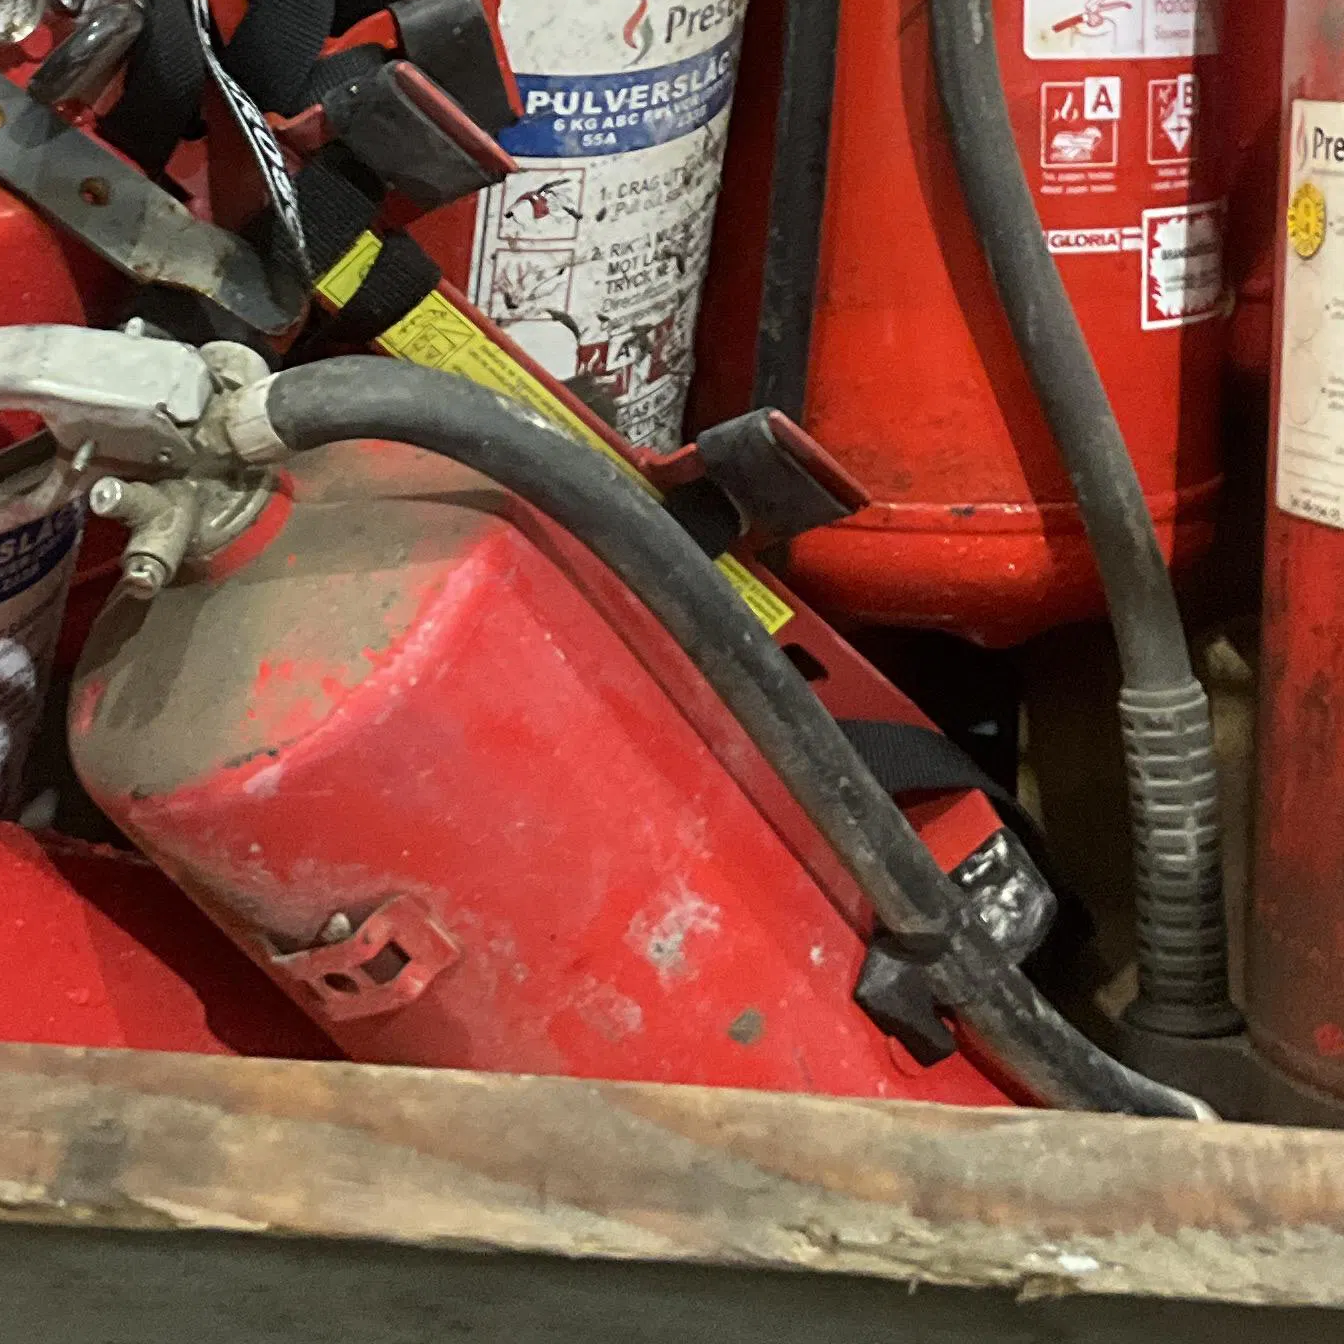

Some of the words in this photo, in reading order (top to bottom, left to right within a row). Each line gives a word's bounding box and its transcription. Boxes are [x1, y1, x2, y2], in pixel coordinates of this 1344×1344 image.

[1092, 93, 1114, 114] A
[553, 118, 566, 132] 6
[570, 117, 598, 132] KG
[602, 112, 640, 130] ABC
[1051, 233, 1118, 249] GLORIA
